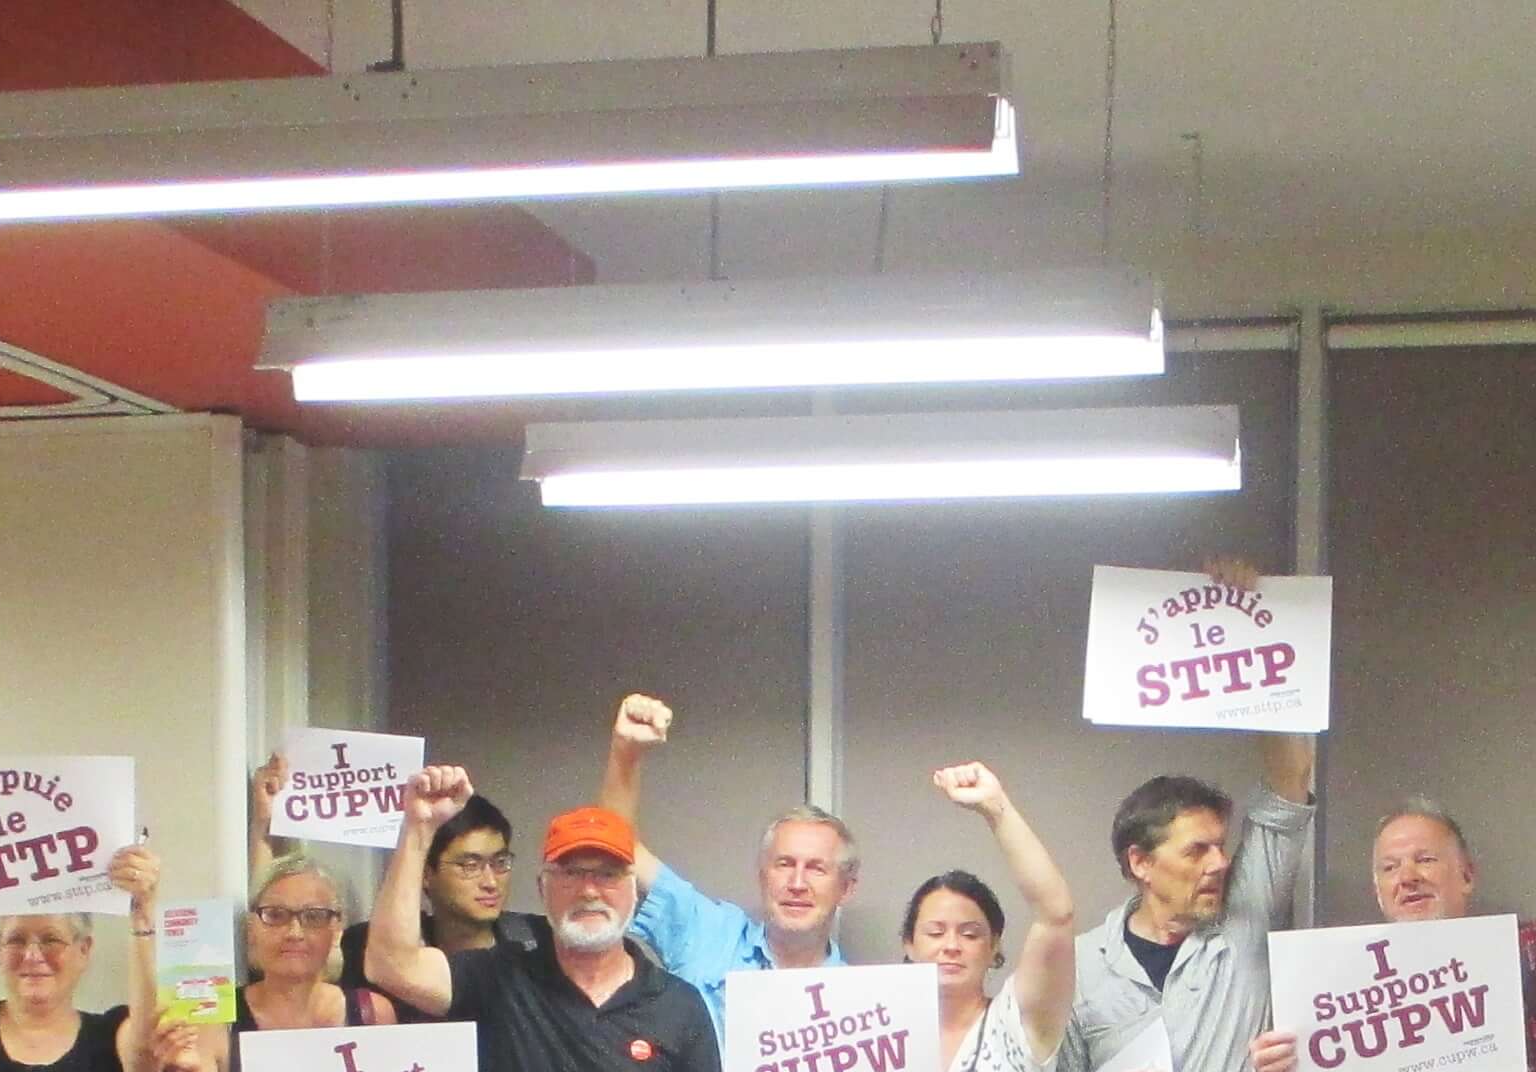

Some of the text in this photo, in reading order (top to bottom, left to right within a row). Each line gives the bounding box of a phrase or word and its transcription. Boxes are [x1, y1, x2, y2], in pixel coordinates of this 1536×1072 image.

[1137, 583, 1273, 645] J'appuie
[1189, 623, 1226, 648] le
[1136, 642, 1296, 707] STTP
[293, 763, 396, 790] Support
[332, 743, 350, 769] I
[285, 784, 408, 822] CUPW
[1366, 939, 1397, 980] I
[804, 982, 831, 1020] I
[1313, 957, 1468, 1022] Support
[758, 1002, 891, 1057] Support
[1308, 984, 1489, 1069] CUPW
